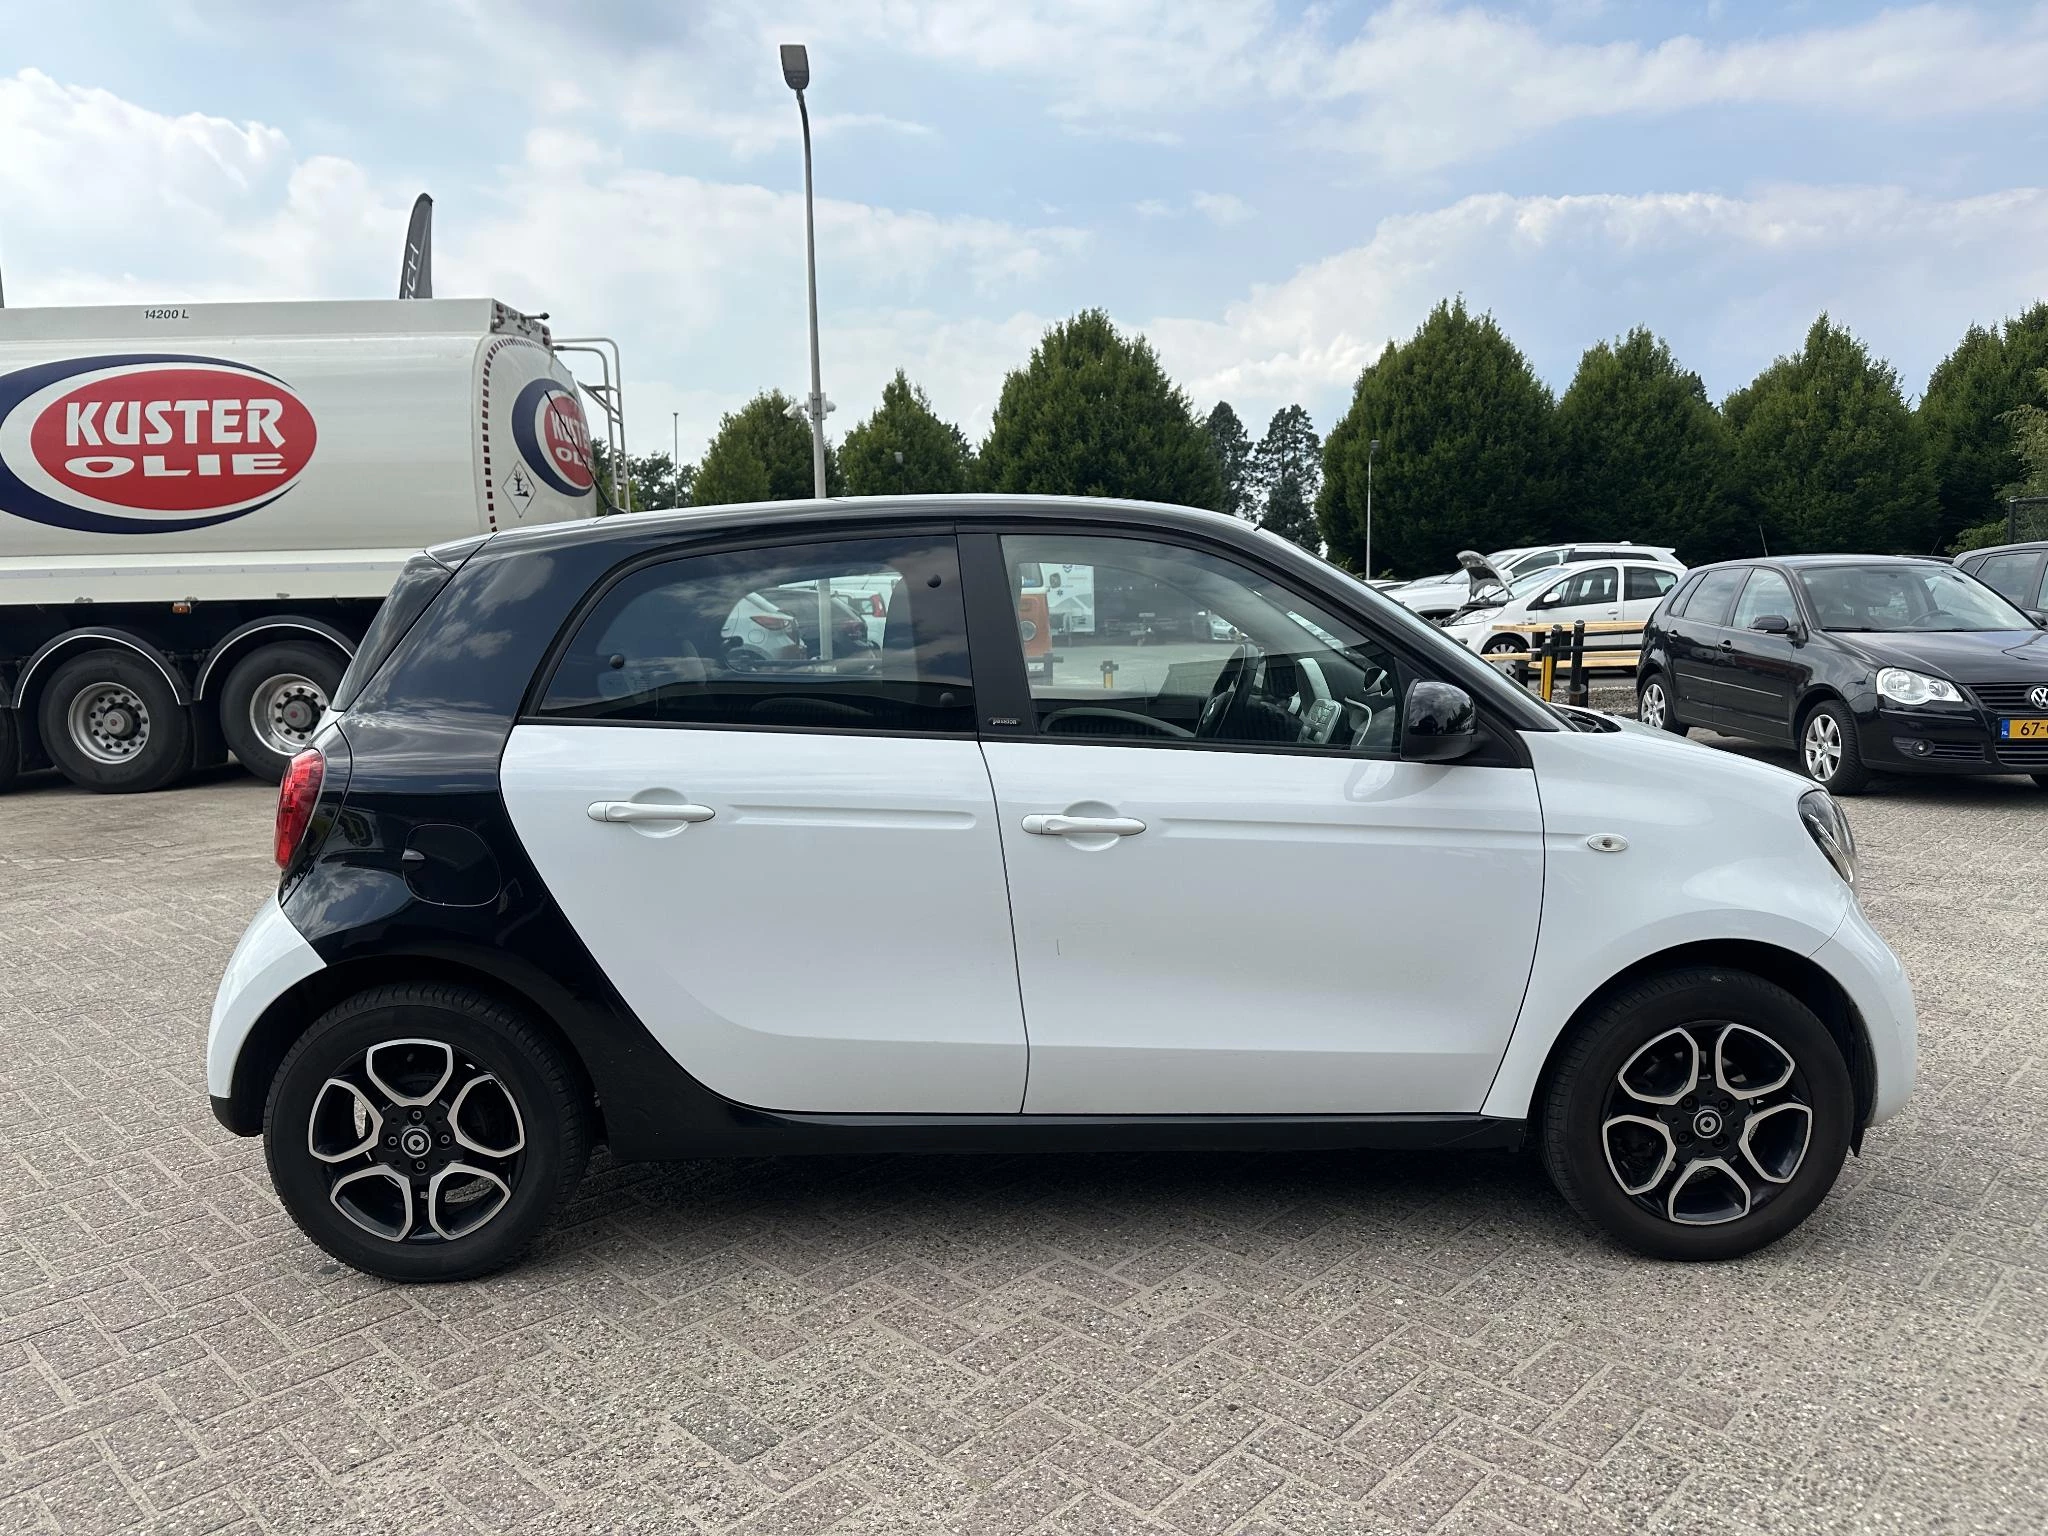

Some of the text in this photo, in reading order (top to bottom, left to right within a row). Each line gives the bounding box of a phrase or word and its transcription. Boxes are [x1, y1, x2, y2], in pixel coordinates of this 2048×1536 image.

[144, 309, 189, 319] 14200 L
[66, 399, 286, 449] KUSTER
[64, 453, 288, 478] OLIE
[2020, 722, 2048, 736] 67-
